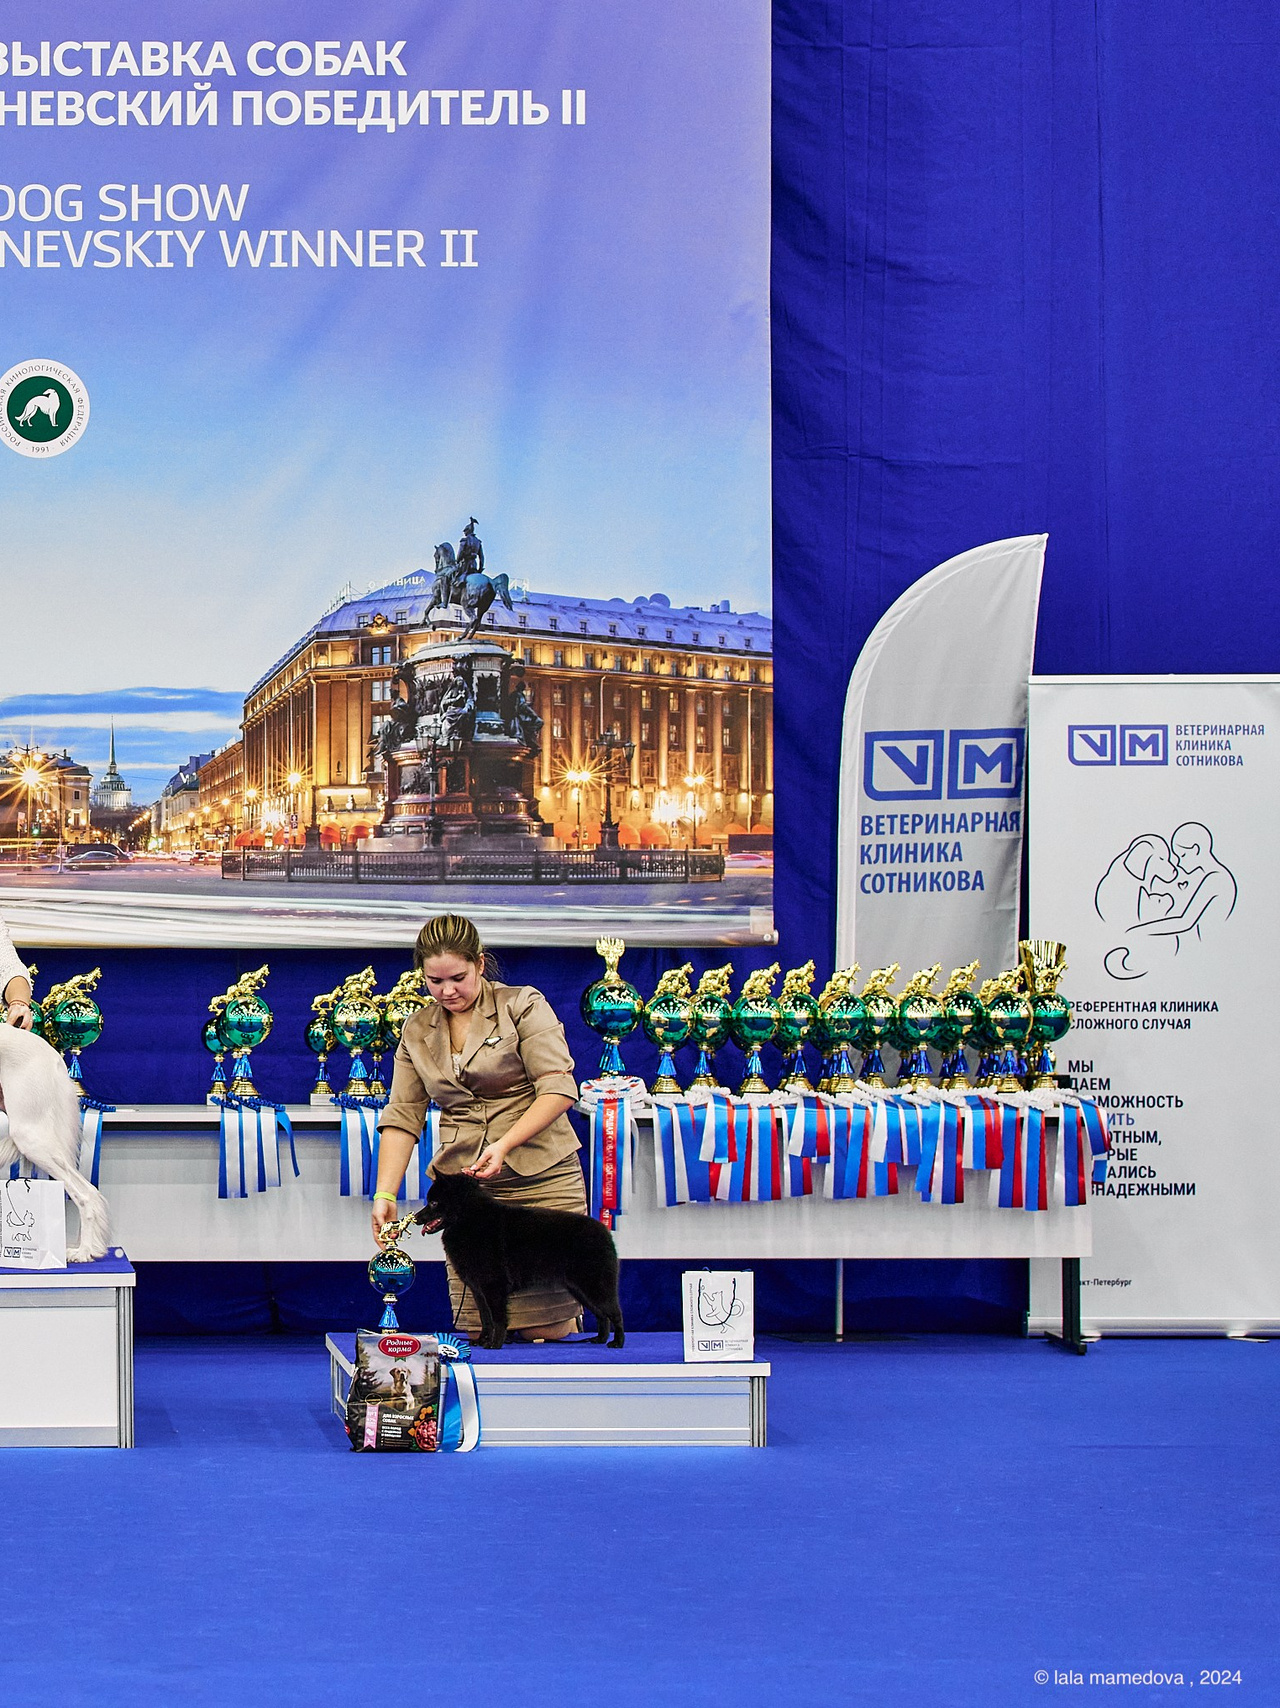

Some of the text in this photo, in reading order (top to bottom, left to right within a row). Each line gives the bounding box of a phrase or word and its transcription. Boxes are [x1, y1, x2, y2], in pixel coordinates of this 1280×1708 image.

[246, 41, 407, 76] СОБАК
[232, 90, 549, 133] ПОБЕДИТЕЛЬ
[562, 89, 586, 125] II
[99, 183, 249, 222] SHOW
[219, 230, 426, 268] WINNER
[440, 230, 478, 268] II
[5, 365, 80, 394] КИНОЛОГИЧЕСКАЯ
[59, 397, 84, 447] ФЕДЕРАЦИЯ
[1175, 724, 1265, 736] ВЕТЕРИНАРНАЯ
[1175, 740, 1232, 751] КЛИНИКА
[1175, 755, 1244, 766] СОТНИКОВА
[860, 811, 1021, 836] ВЕТЕРИНАРНАЯ
[860, 841, 963, 865] КЛИНИКА
[860, 870, 985, 894] СОТНИКОВА
[1160, 1001, 1219, 1012] КЛИНИКА
[1142, 1018, 1191, 1030] СЛУЧАЯ
[1068, 1060, 1094, 1073] МЫ
[1070, 1078, 1111, 1092] ДАЕМ
[1093, 1095, 1184, 1108] МОЖНОСТЬ
[1092, 1183, 1196, 1199] НАДЕЖНЫМИ
[1080, 1278, 1132, 1287] кт-Петербург
